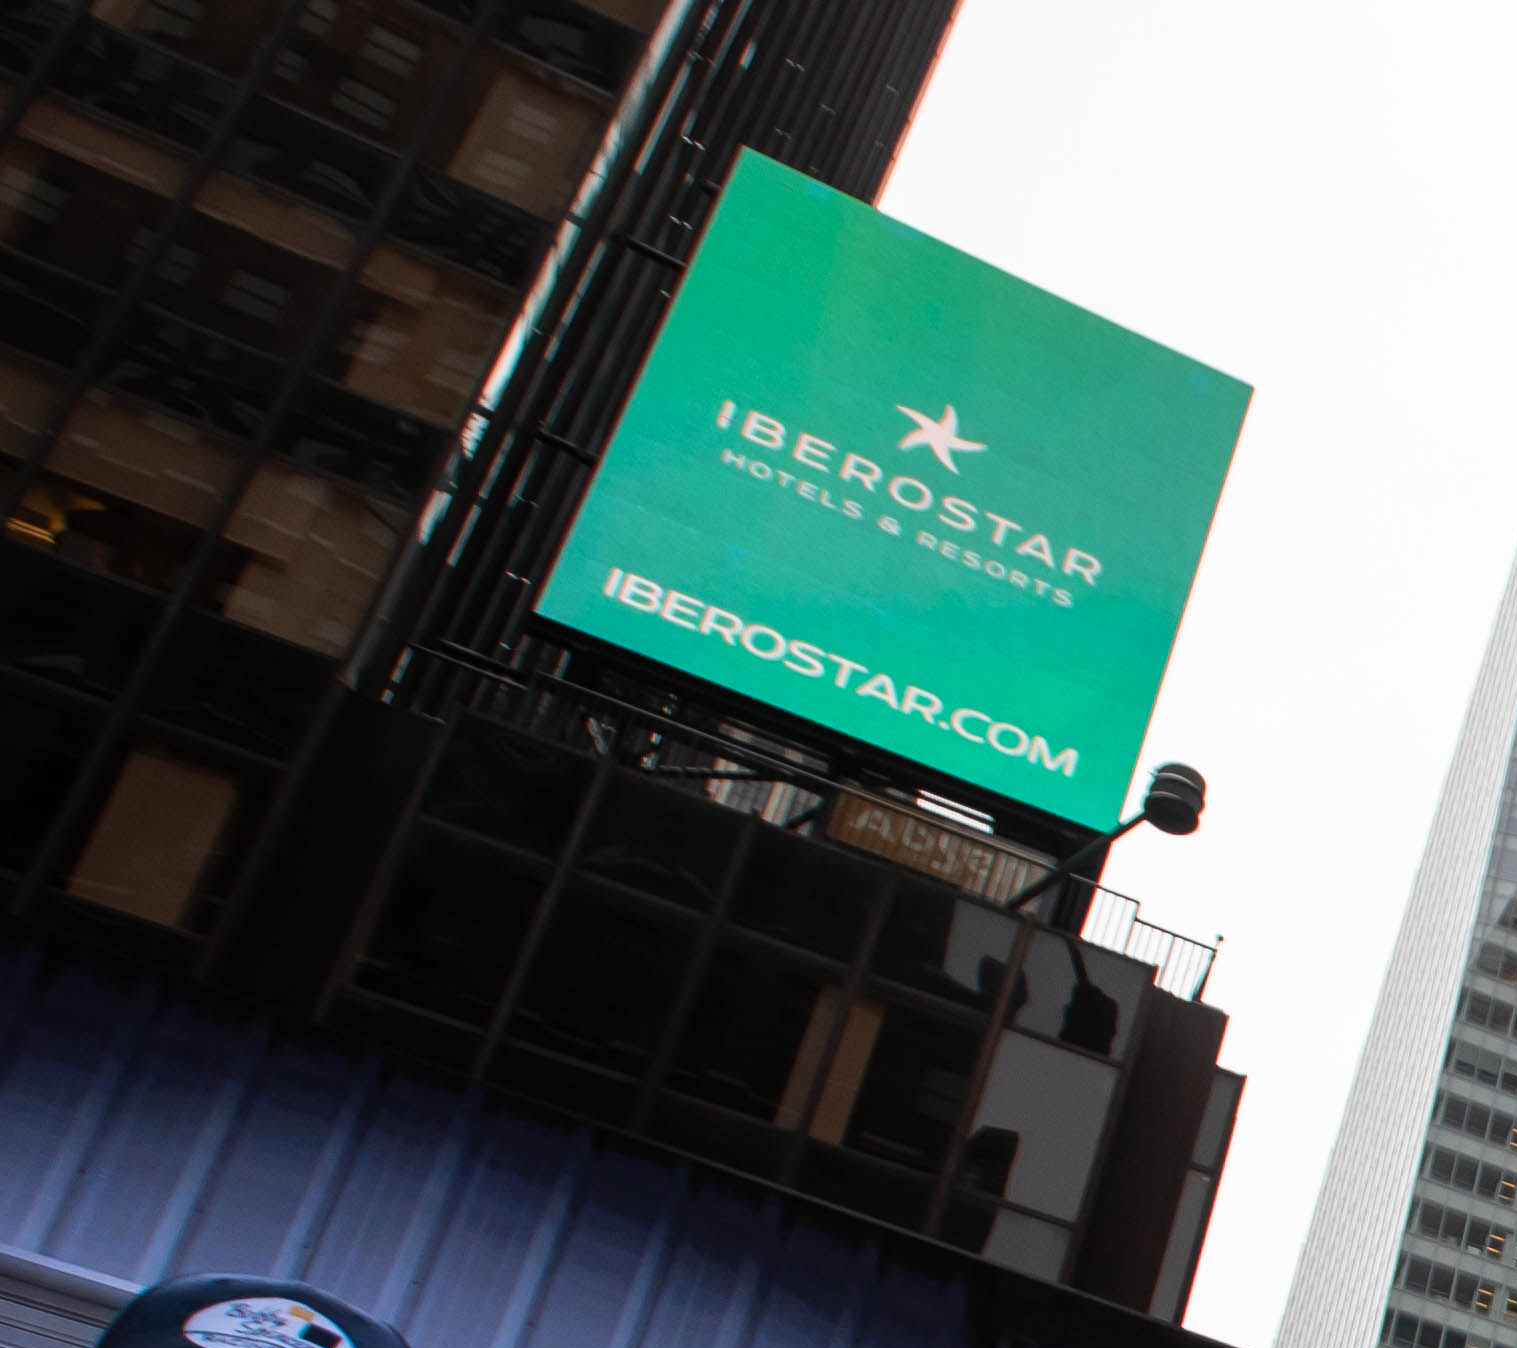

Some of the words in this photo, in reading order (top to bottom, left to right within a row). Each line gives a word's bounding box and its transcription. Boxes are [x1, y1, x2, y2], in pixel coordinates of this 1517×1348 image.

[716, 400, 1103, 586] IBEROSTAR
[722, 448, 864, 520] HOTELS
[878, 514, 901, 535] &
[916, 530, 1073, 607] RESORTS
[603, 566, 1078, 778] IBEROSTAR.COM
